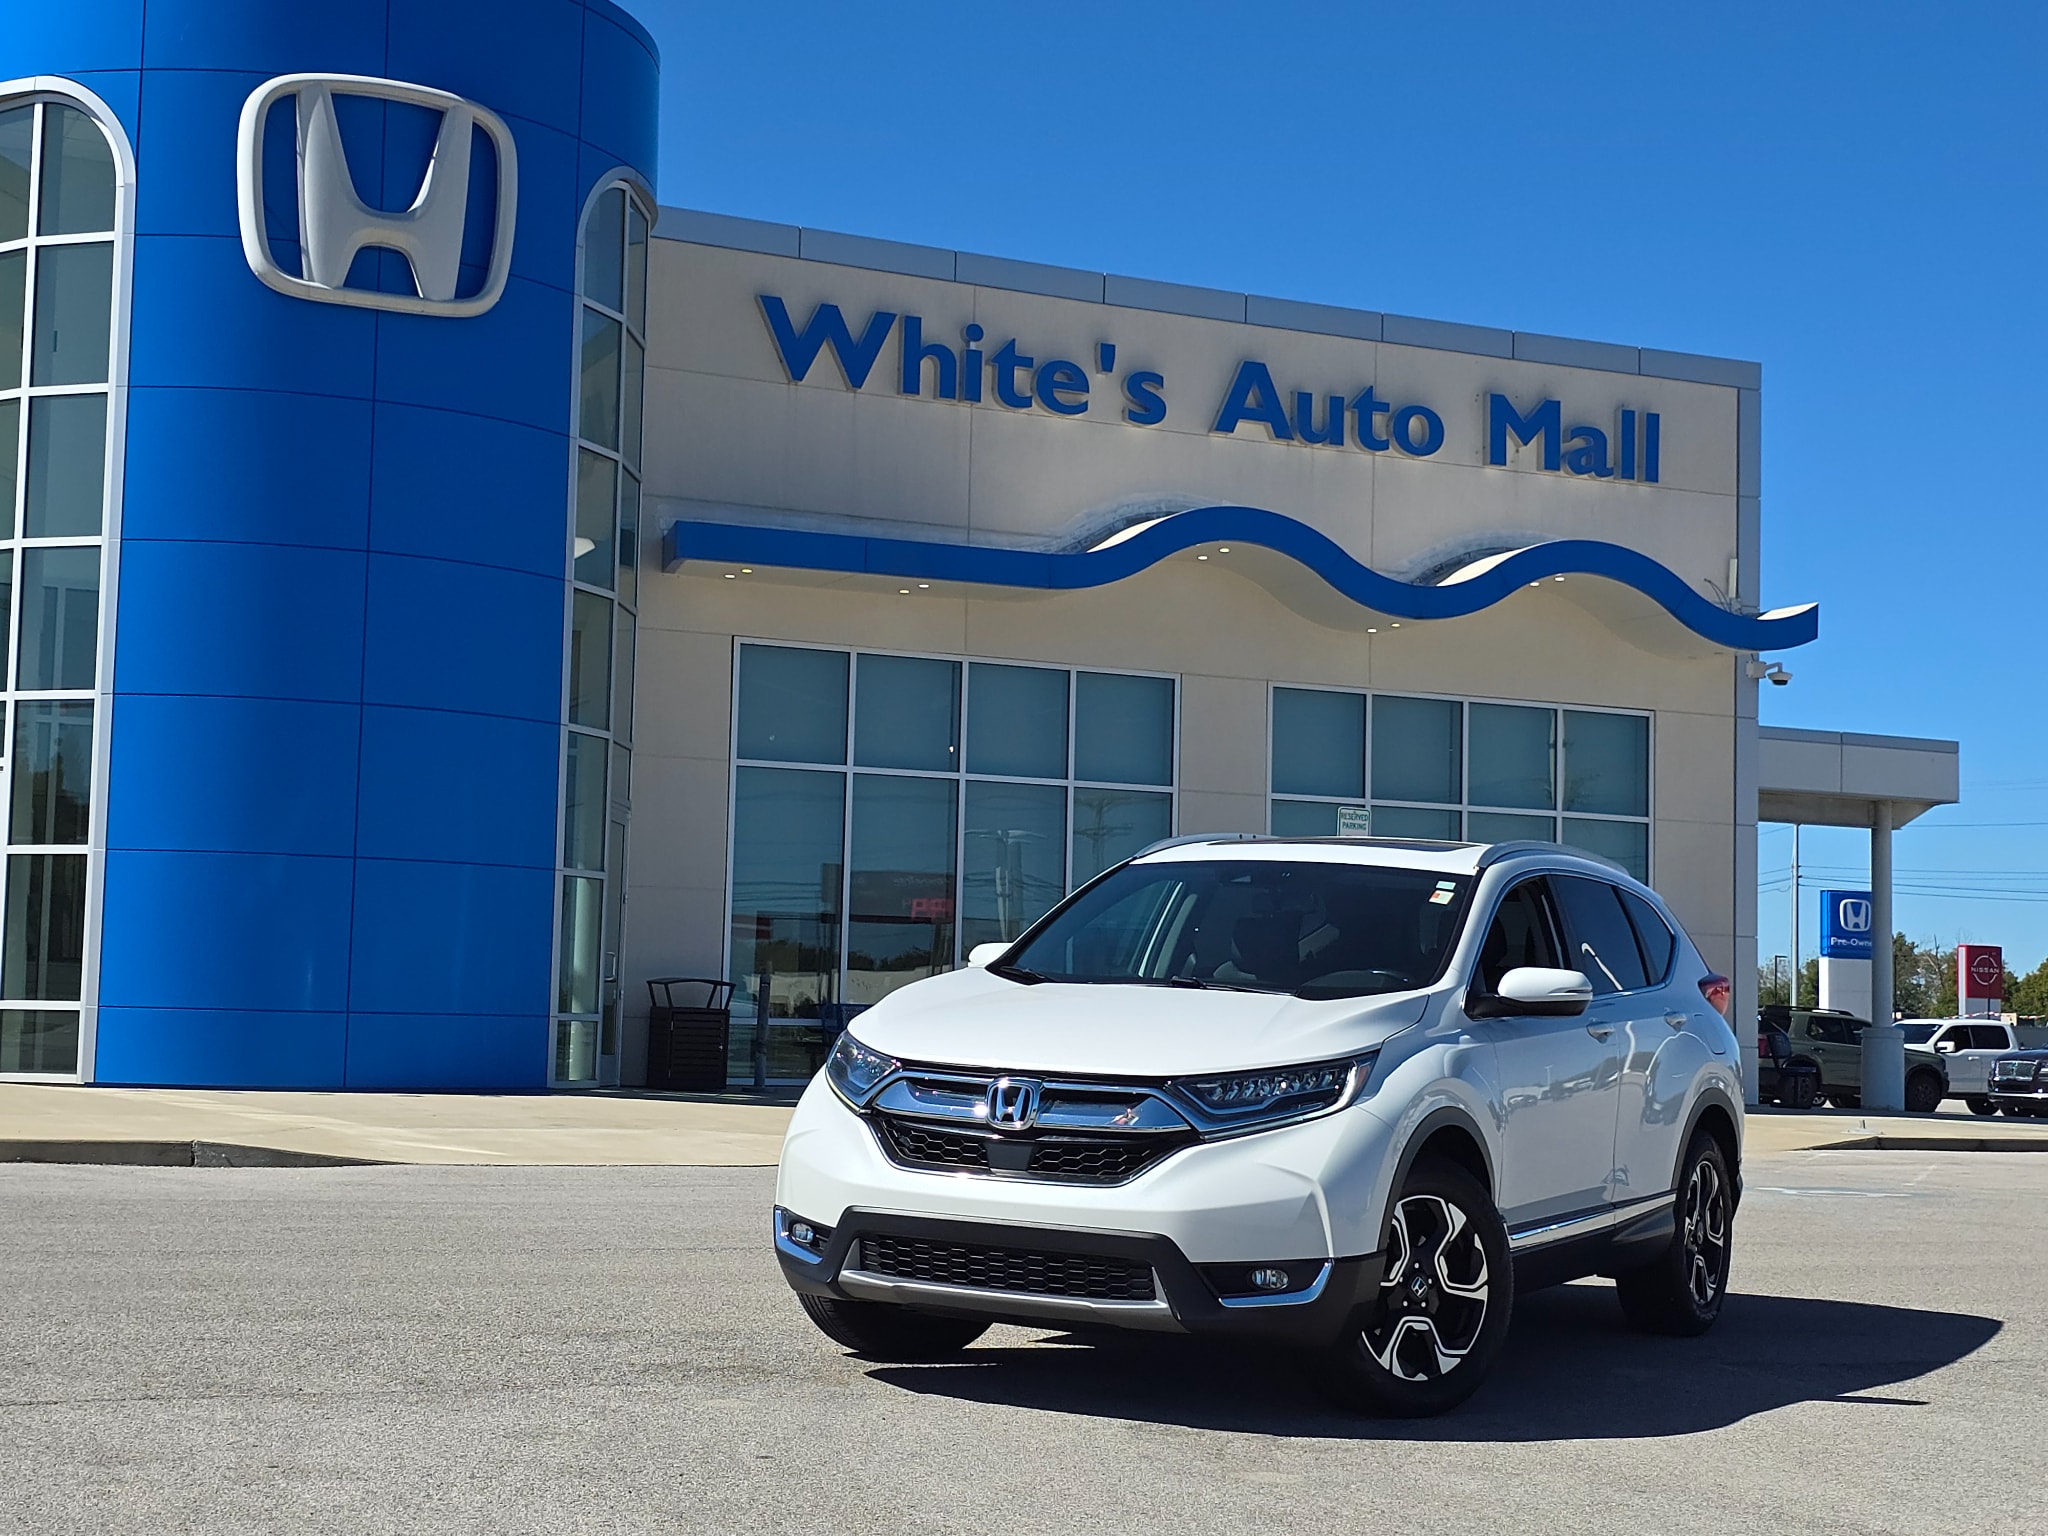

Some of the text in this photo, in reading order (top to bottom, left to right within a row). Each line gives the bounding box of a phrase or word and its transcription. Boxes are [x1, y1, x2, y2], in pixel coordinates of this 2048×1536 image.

[757, 294, 1660, 483] White's Auto Mall
[1340, 812, 1368, 822] RESERVED
[1342, 821, 1367, 831] PARKING
[1830, 936, 1872, 947] Pre-Owne
[1970, 966, 2000, 974] NISSAN
